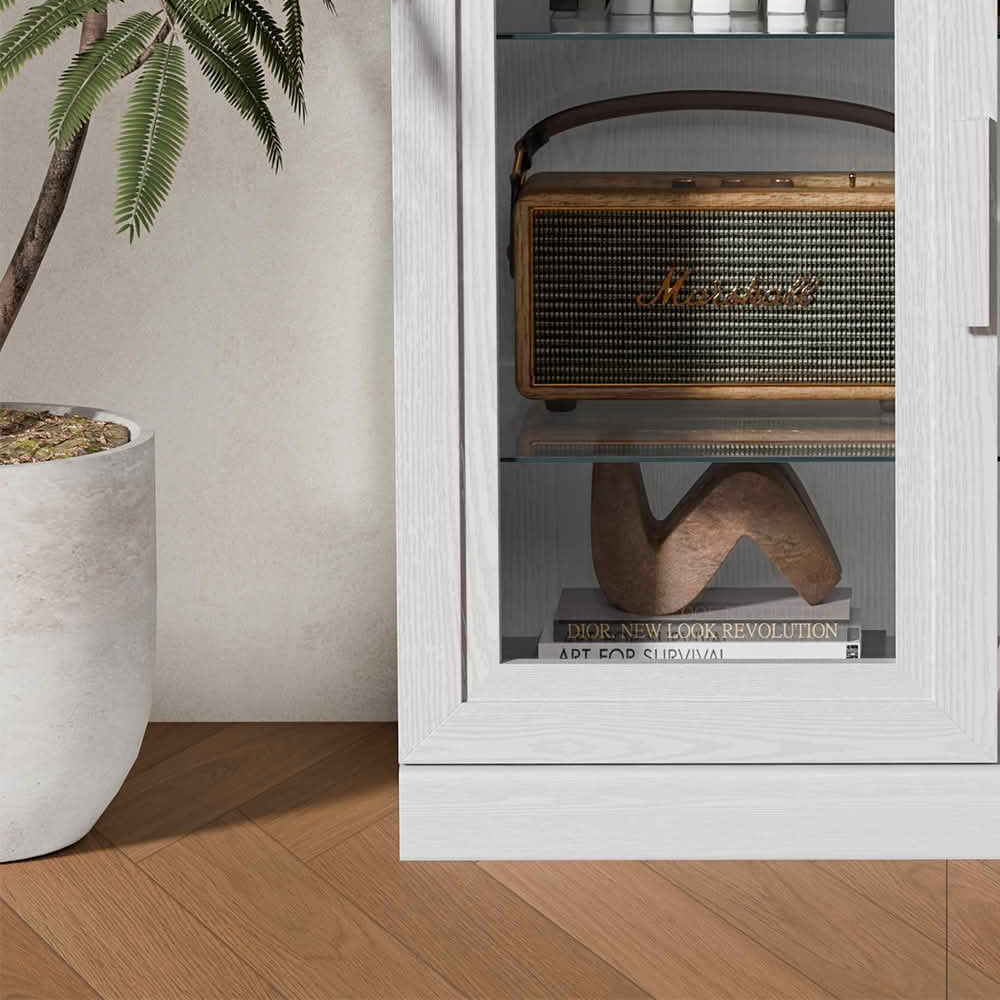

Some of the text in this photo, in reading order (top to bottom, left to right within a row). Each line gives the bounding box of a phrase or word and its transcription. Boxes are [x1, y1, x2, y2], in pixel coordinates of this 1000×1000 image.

[621, 623, 662, 639] NEW
[667, 623, 718, 639] LOOK
[722, 623, 839, 639] REVOLUTION
